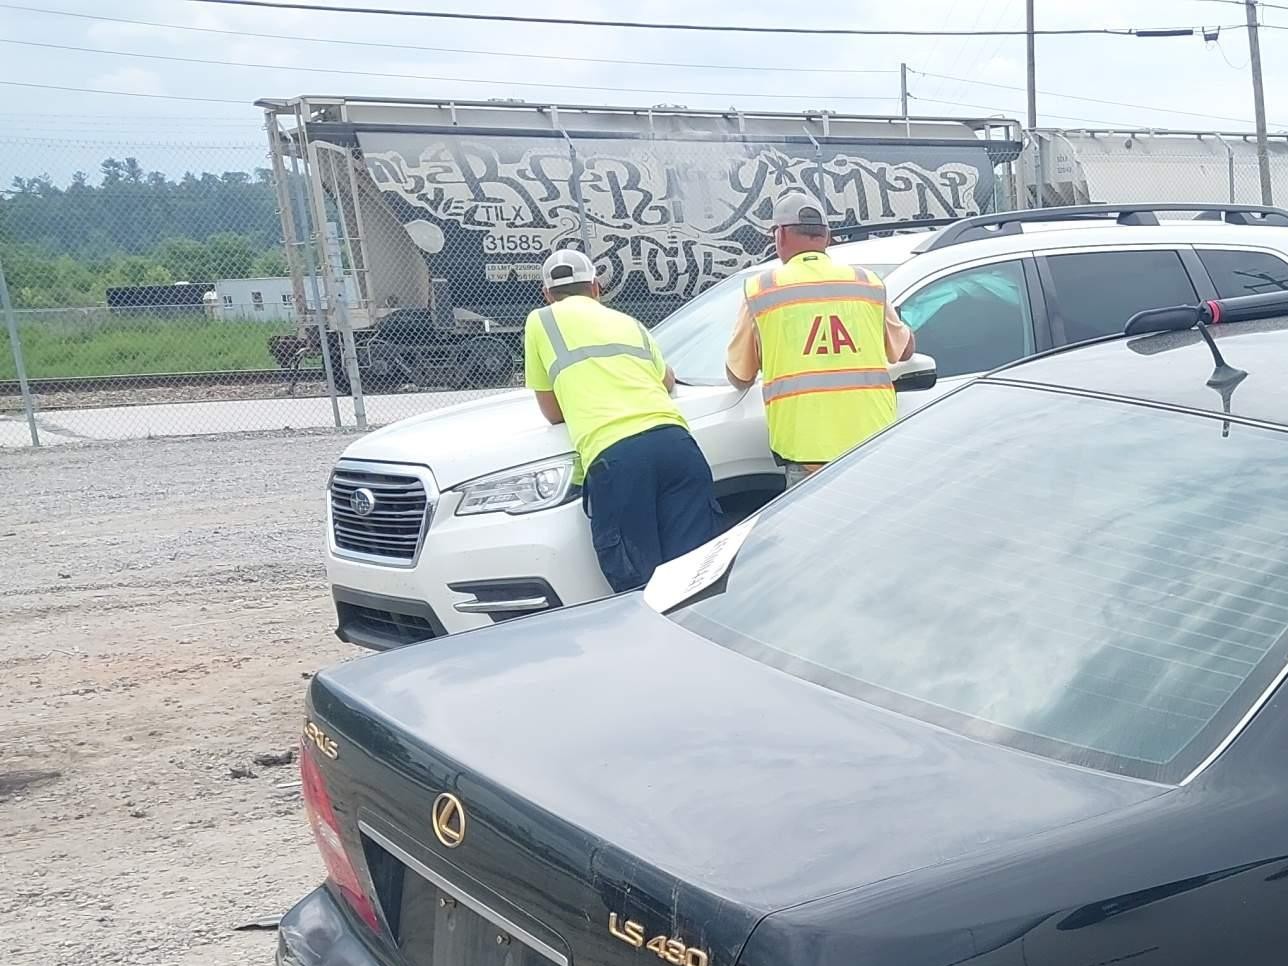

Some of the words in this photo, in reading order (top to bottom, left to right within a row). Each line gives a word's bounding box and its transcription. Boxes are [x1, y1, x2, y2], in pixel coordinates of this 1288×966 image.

[480, 205, 525, 221] TILX
[485, 234, 544, 251] 31585
[608, 911, 645, 948] LS
